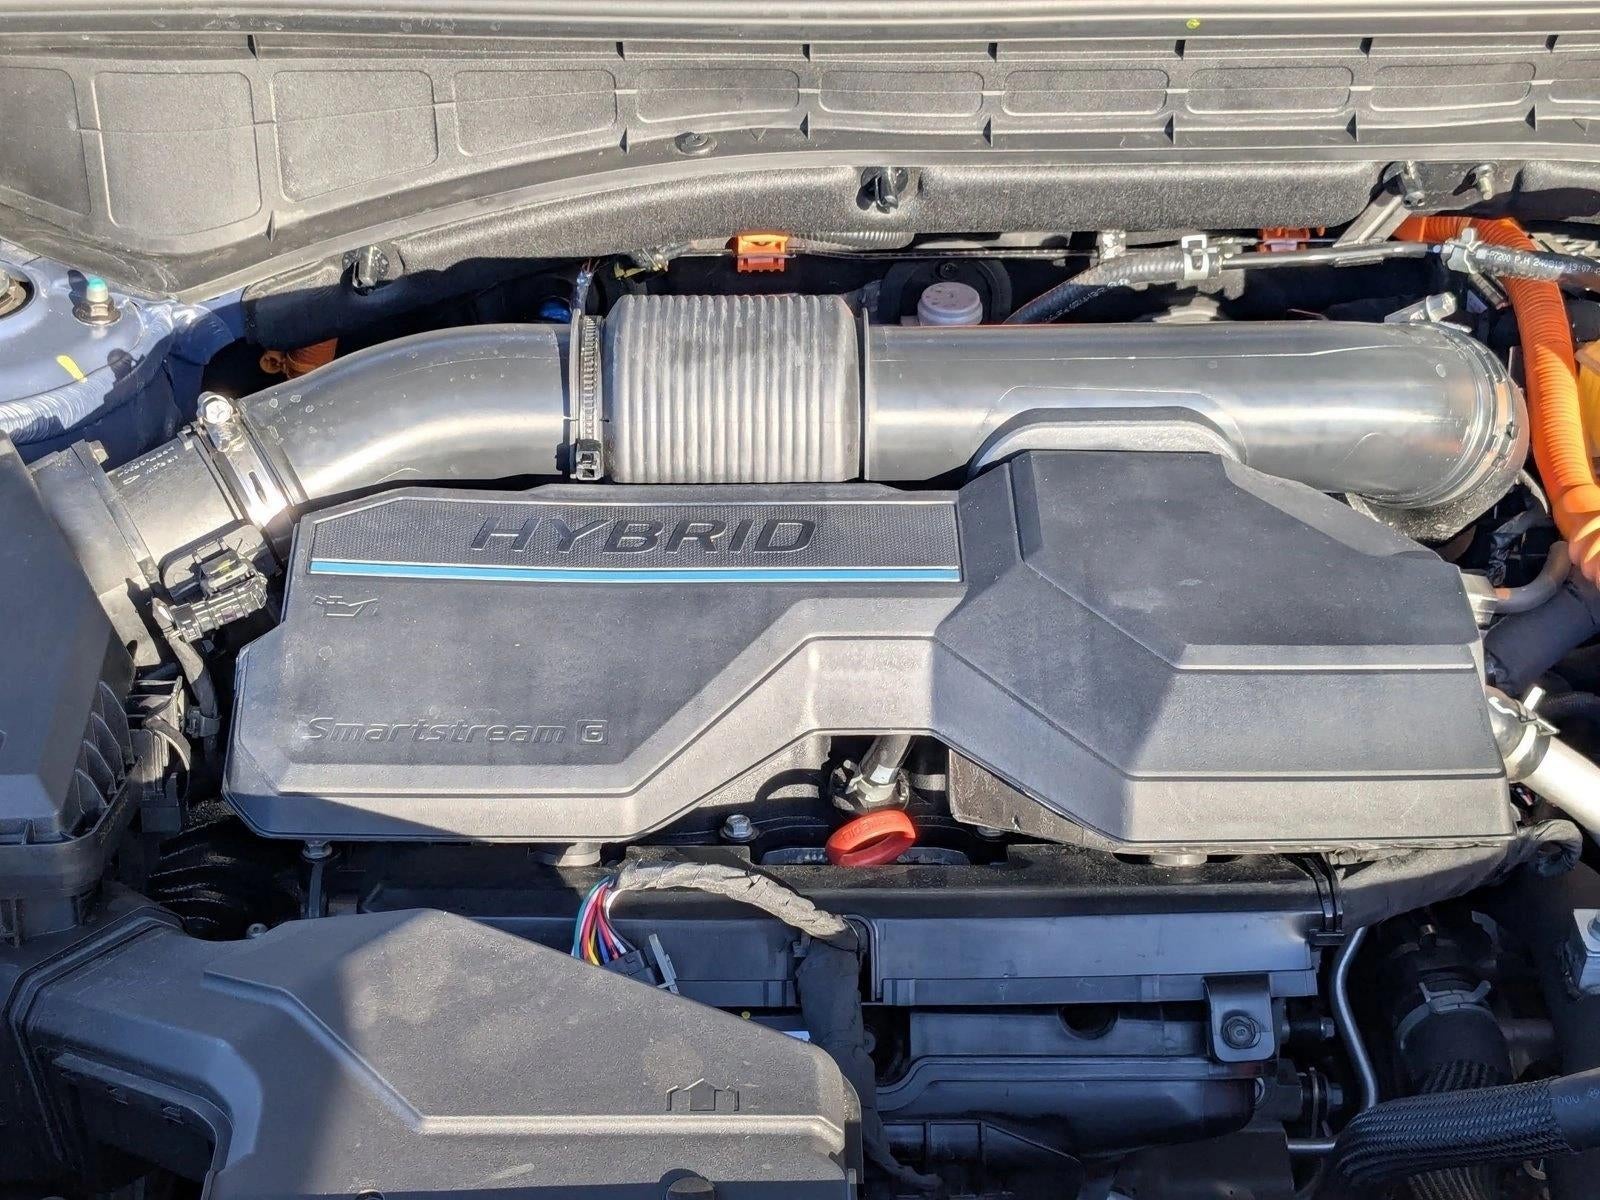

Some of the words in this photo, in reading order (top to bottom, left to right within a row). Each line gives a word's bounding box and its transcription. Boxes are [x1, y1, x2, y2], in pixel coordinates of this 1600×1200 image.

[470, 518, 817, 554] HYBRID
[302, 717, 567, 744] Smartstream
[579, 721, 607, 744] G
